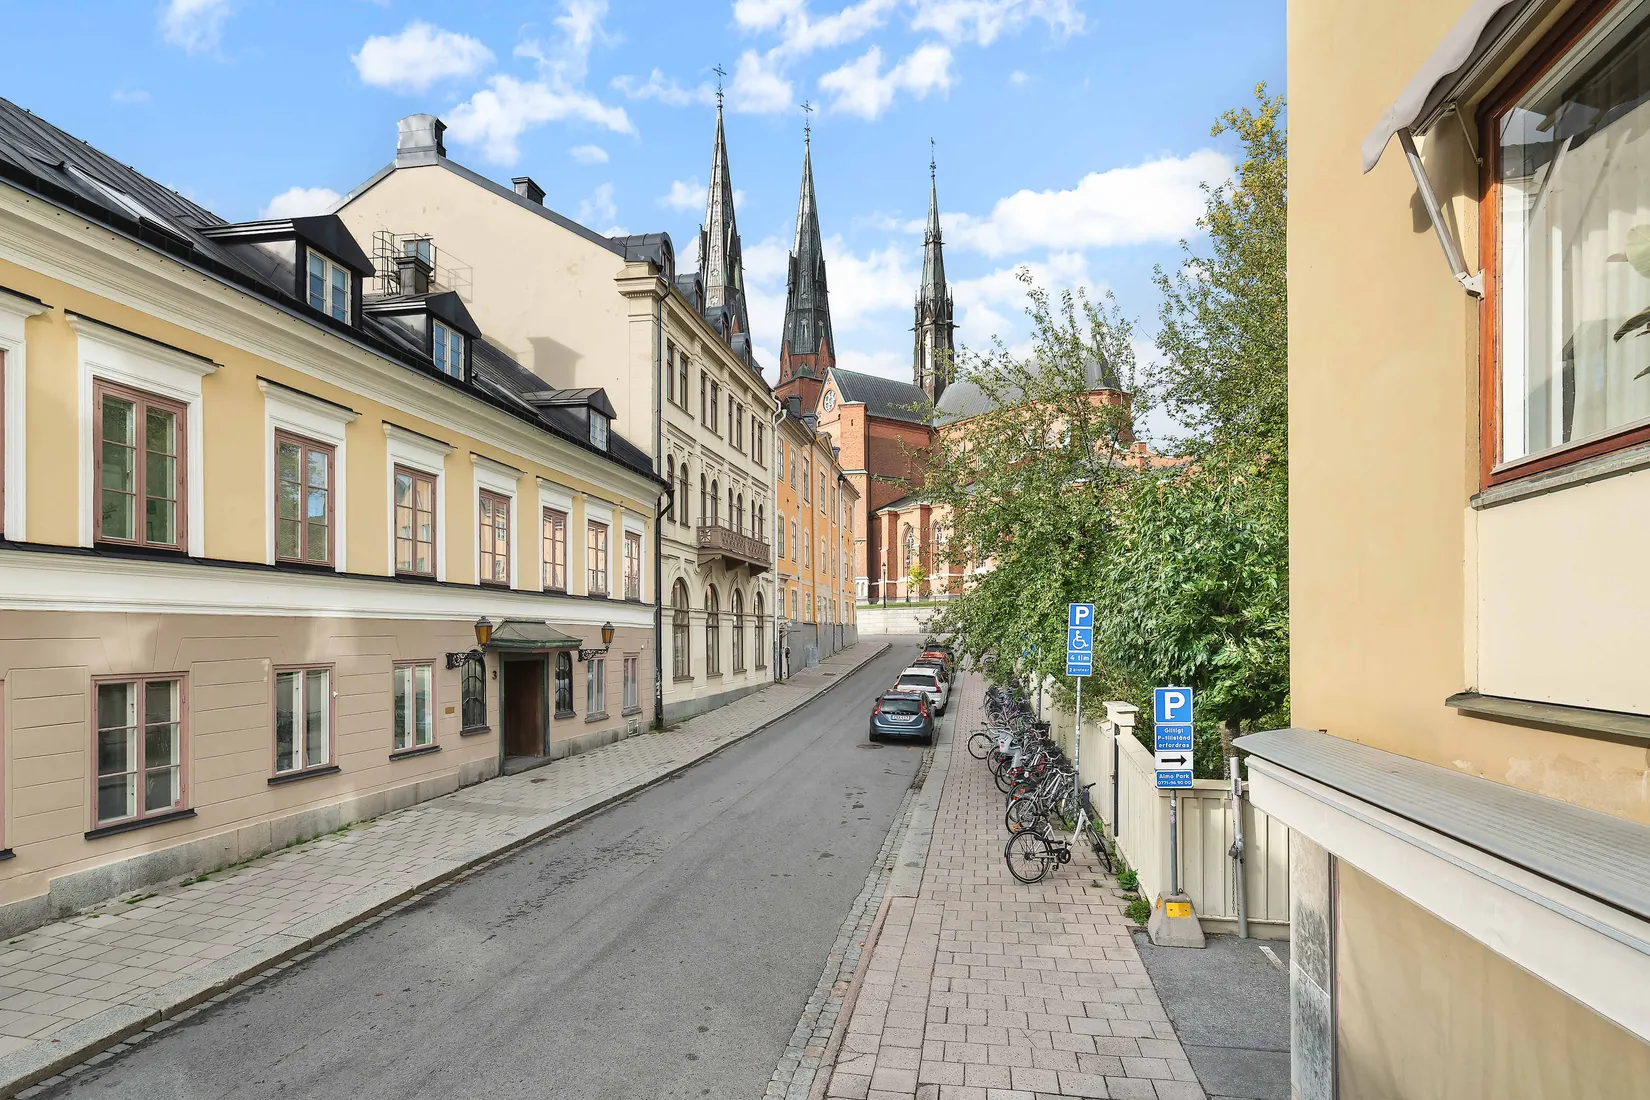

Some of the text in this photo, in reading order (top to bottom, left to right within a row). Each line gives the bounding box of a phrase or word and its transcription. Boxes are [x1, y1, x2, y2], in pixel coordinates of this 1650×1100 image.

[1075, 606, 1089, 625] P
[492, 670, 498, 680] 3
[1164, 691, 1186, 720] P
